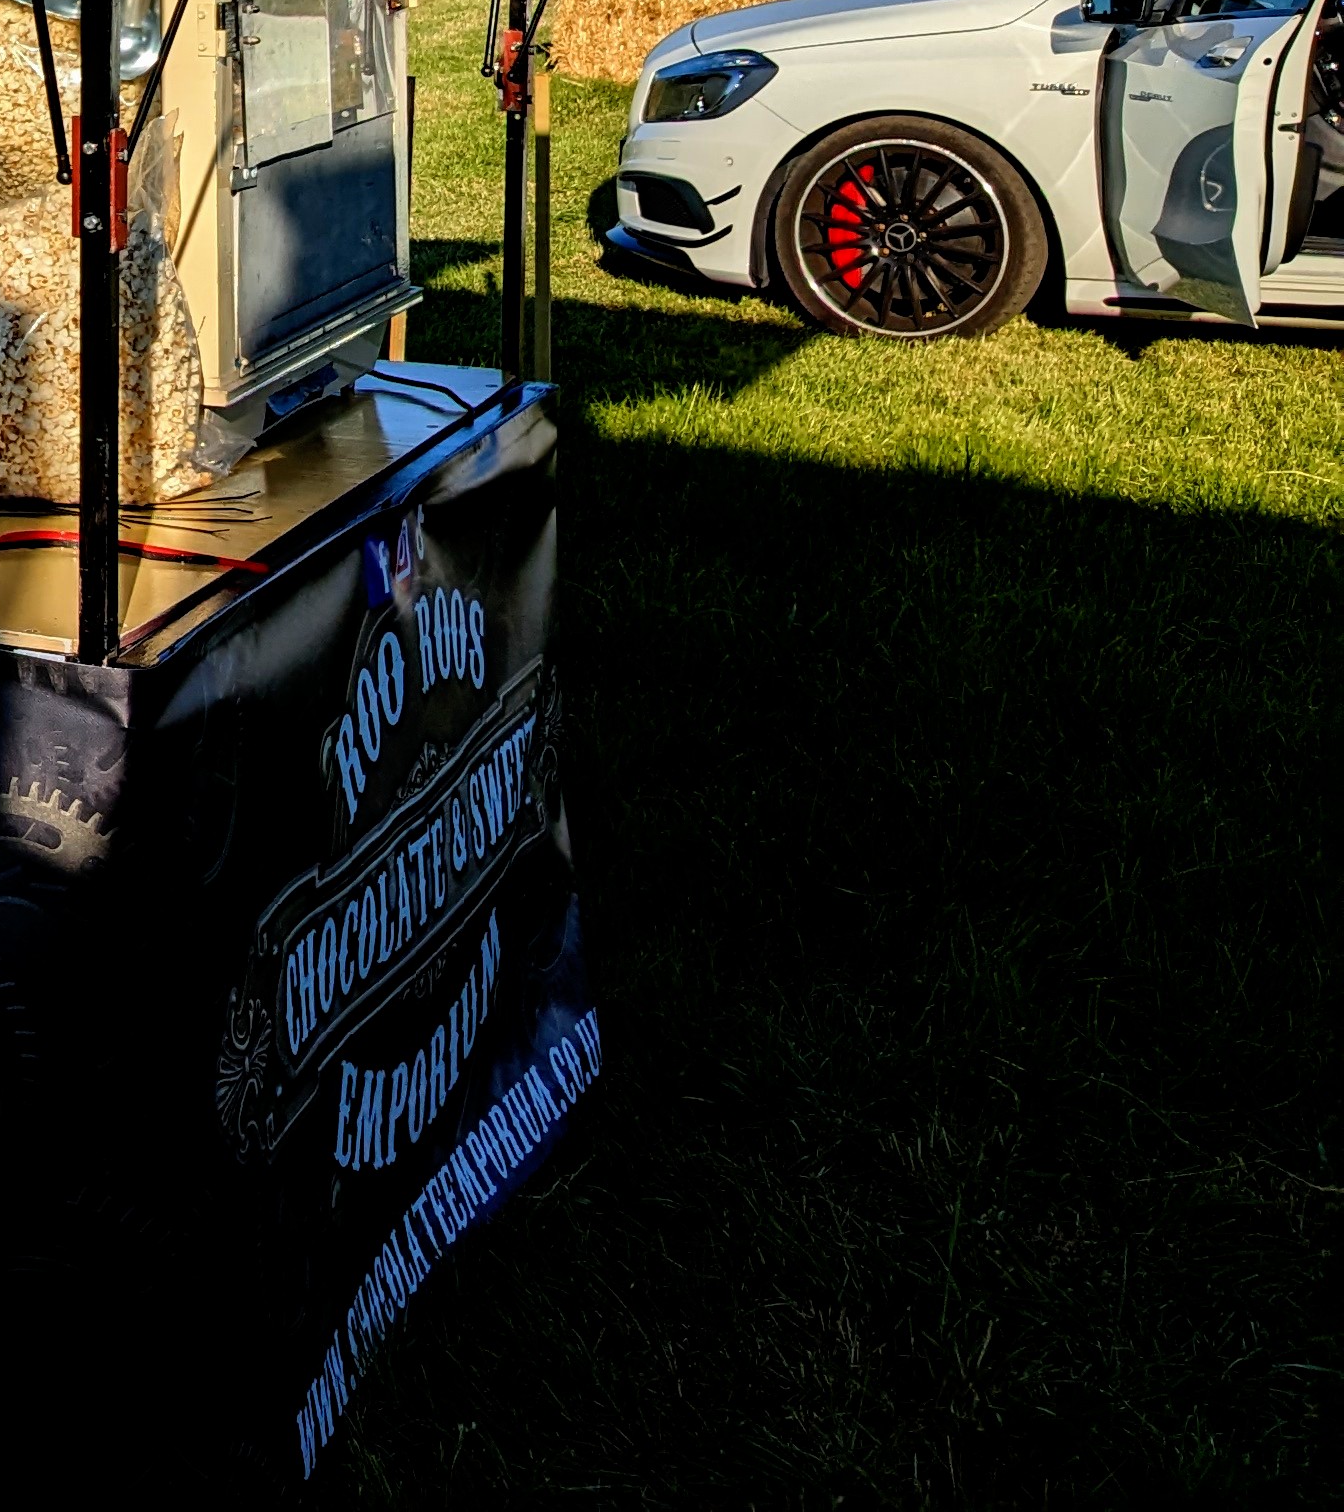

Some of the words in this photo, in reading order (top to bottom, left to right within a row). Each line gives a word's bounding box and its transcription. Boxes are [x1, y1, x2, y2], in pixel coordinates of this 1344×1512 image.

[335, 632, 406, 825] ROO
[414, 587, 486, 694] ROOS
[284, 816, 446, 1058] CHOCOLATE
[452, 797, 468, 872] &
[334, 906, 502, 1172] EMPORIUM
